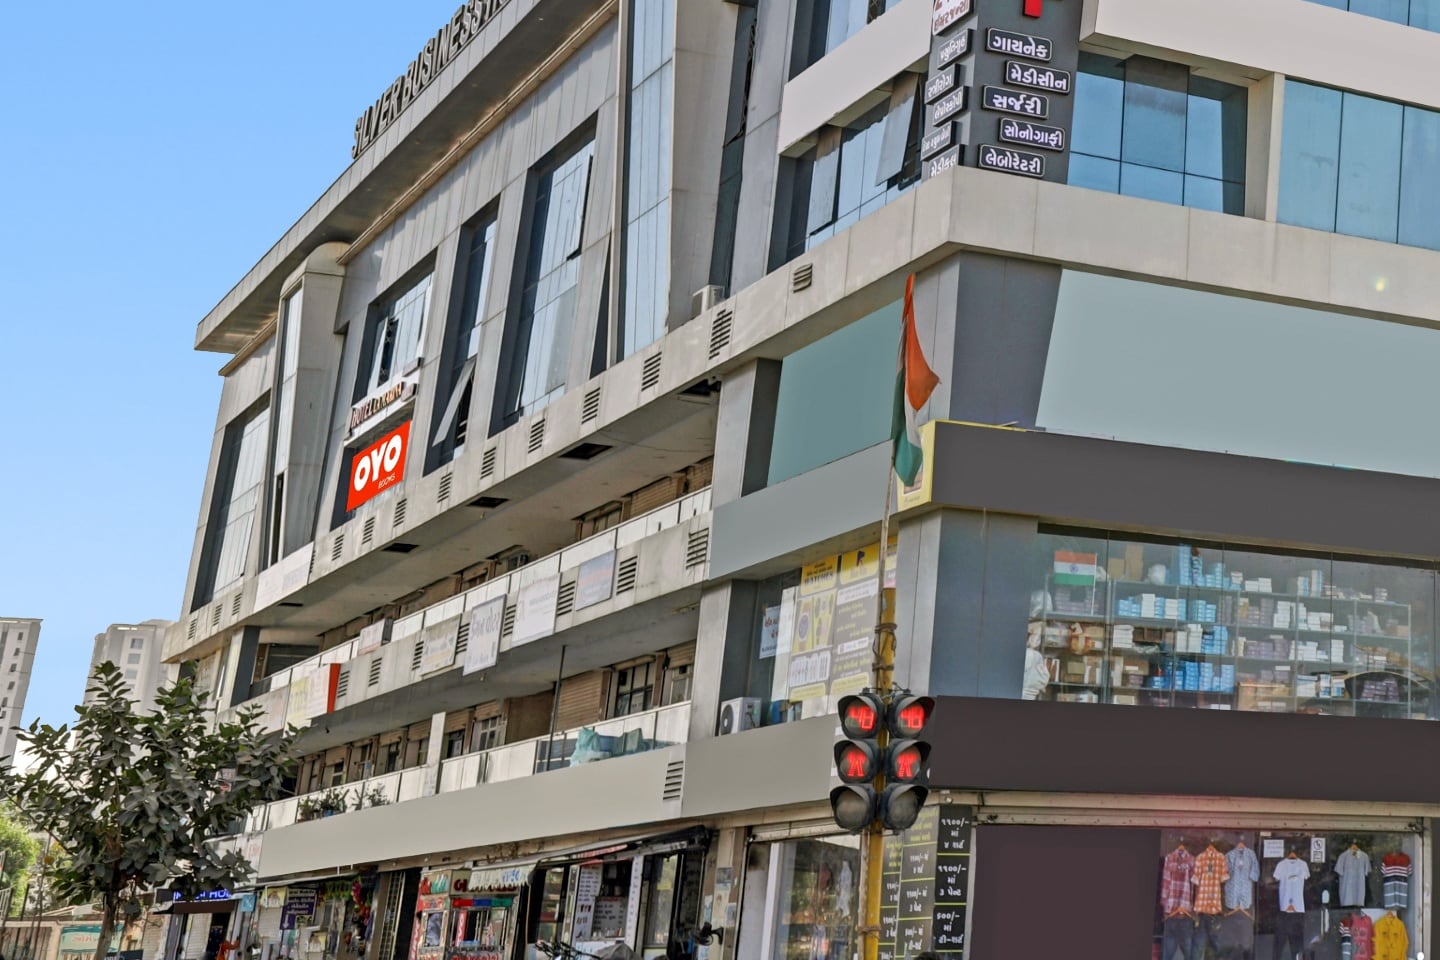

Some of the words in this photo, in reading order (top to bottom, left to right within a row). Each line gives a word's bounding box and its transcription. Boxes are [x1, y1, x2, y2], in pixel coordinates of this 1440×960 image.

[993, 36, 1048, 58] ગાયનેક
[1010, 64, 1067, 90] મેડીસીન
[352, 74, 405, 160] SILVER
[992, 94, 1042, 115] સર્જરી
[1004, 121, 1063, 148] સોનોગ્રાફી
[985, 149, 1041, 174] લેબોરેટરી
[354, 434, 402, 492] OYO
